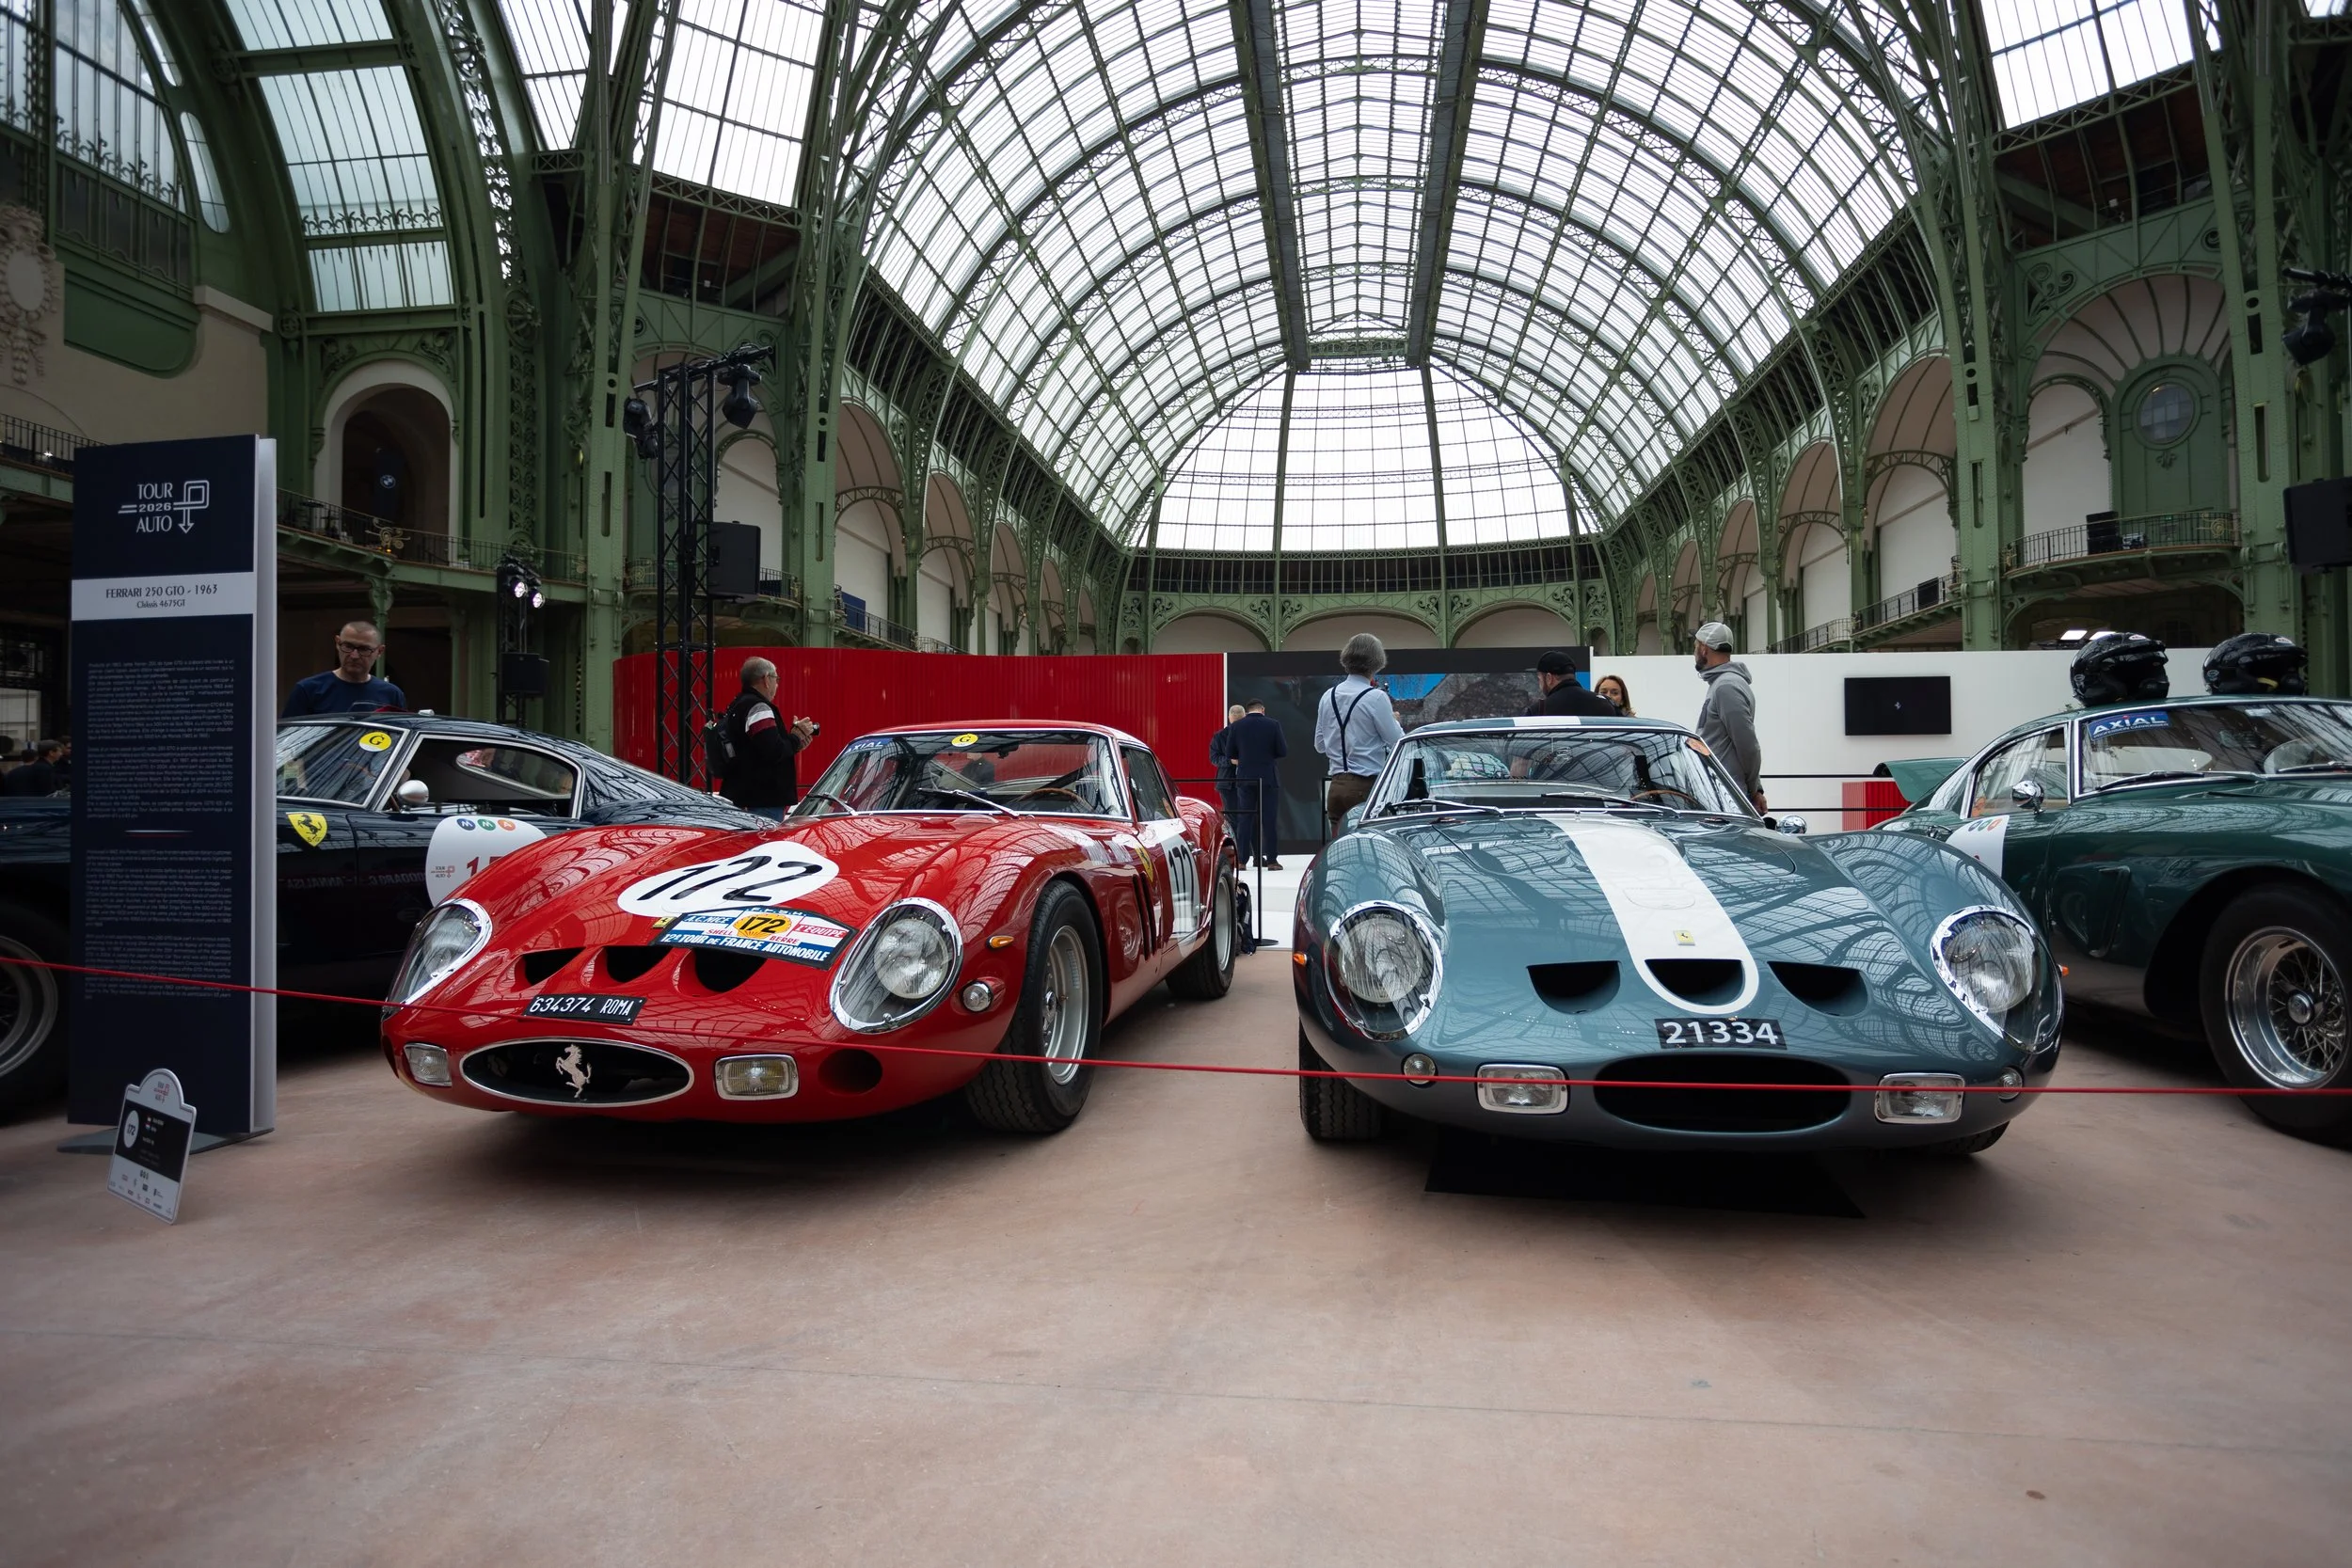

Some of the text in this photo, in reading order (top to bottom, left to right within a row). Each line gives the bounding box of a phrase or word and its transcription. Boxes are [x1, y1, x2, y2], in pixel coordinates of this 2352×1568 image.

[137, 483, 173, 499] TOUR
[139, 502, 171, 513] 2026
[136, 515, 172, 533] AUTO
[106, 587, 142, 599] FERRARI
[145, 586, 164, 597] 250
[166, 585, 185, 596] GTO
[195, 583, 217, 595] 1963
[159, 599, 185, 608] 4675GT
[369, 735, 384, 745] G
[637, 855, 823, 901] 172
[739, 916, 787, 933] 172
[677, 934, 709, 944] TOUR
[719, 937, 766, 952] FRANCE
[761, 942, 831, 961] AUTOMOBILE
[769, 935, 800, 944] BERRE
[529, 997, 634, 1016] 634374 ROMA
[1662, 1021, 1778, 1045] 21334
